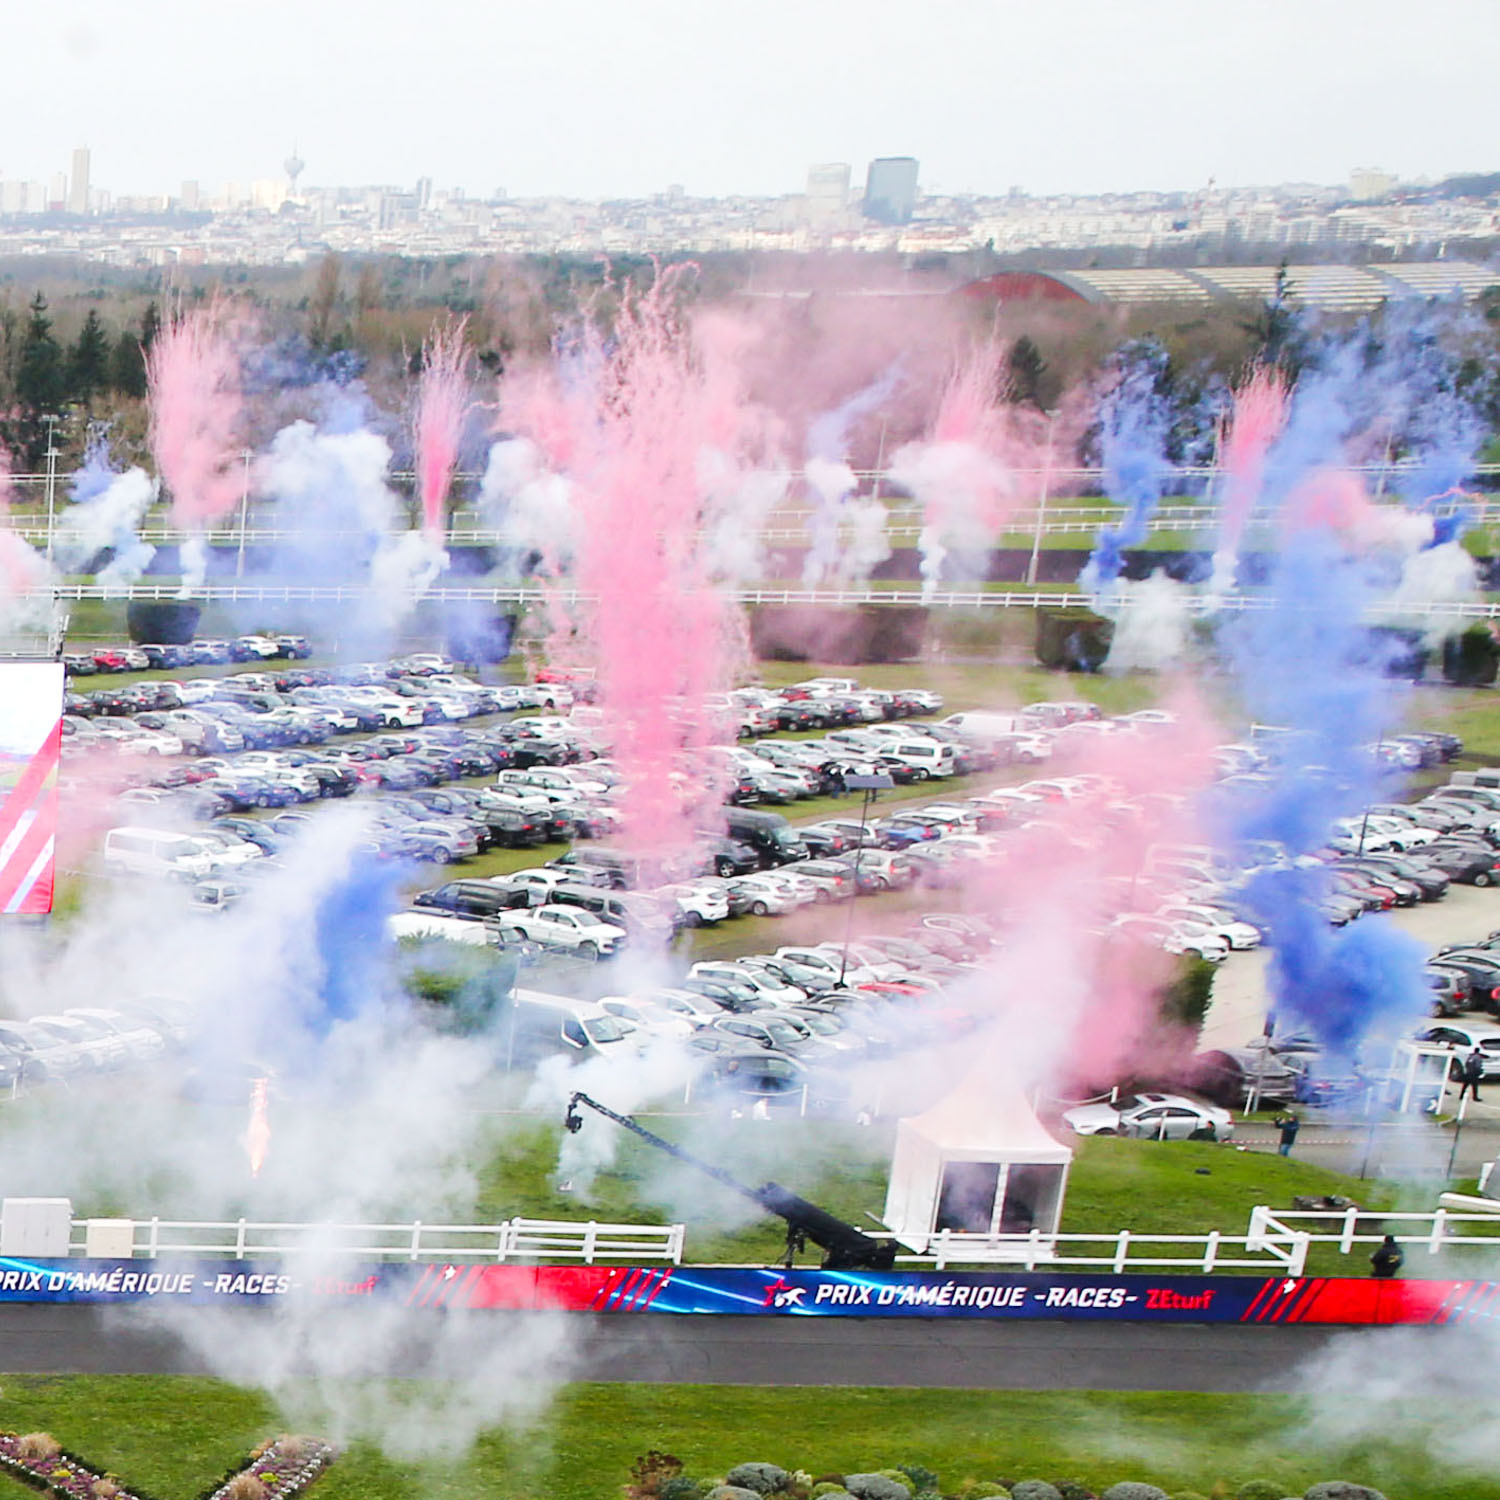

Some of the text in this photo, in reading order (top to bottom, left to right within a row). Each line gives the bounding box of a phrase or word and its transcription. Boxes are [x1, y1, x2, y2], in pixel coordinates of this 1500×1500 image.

[49, 1267, 193, 1295] D'AMÉRIQUE
[815, 1284, 872, 1305] PRIX
[878, 1280, 1026, 1310] D'AMÉRIQUE
[1145, 1289, 1215, 1311] ZEturf
